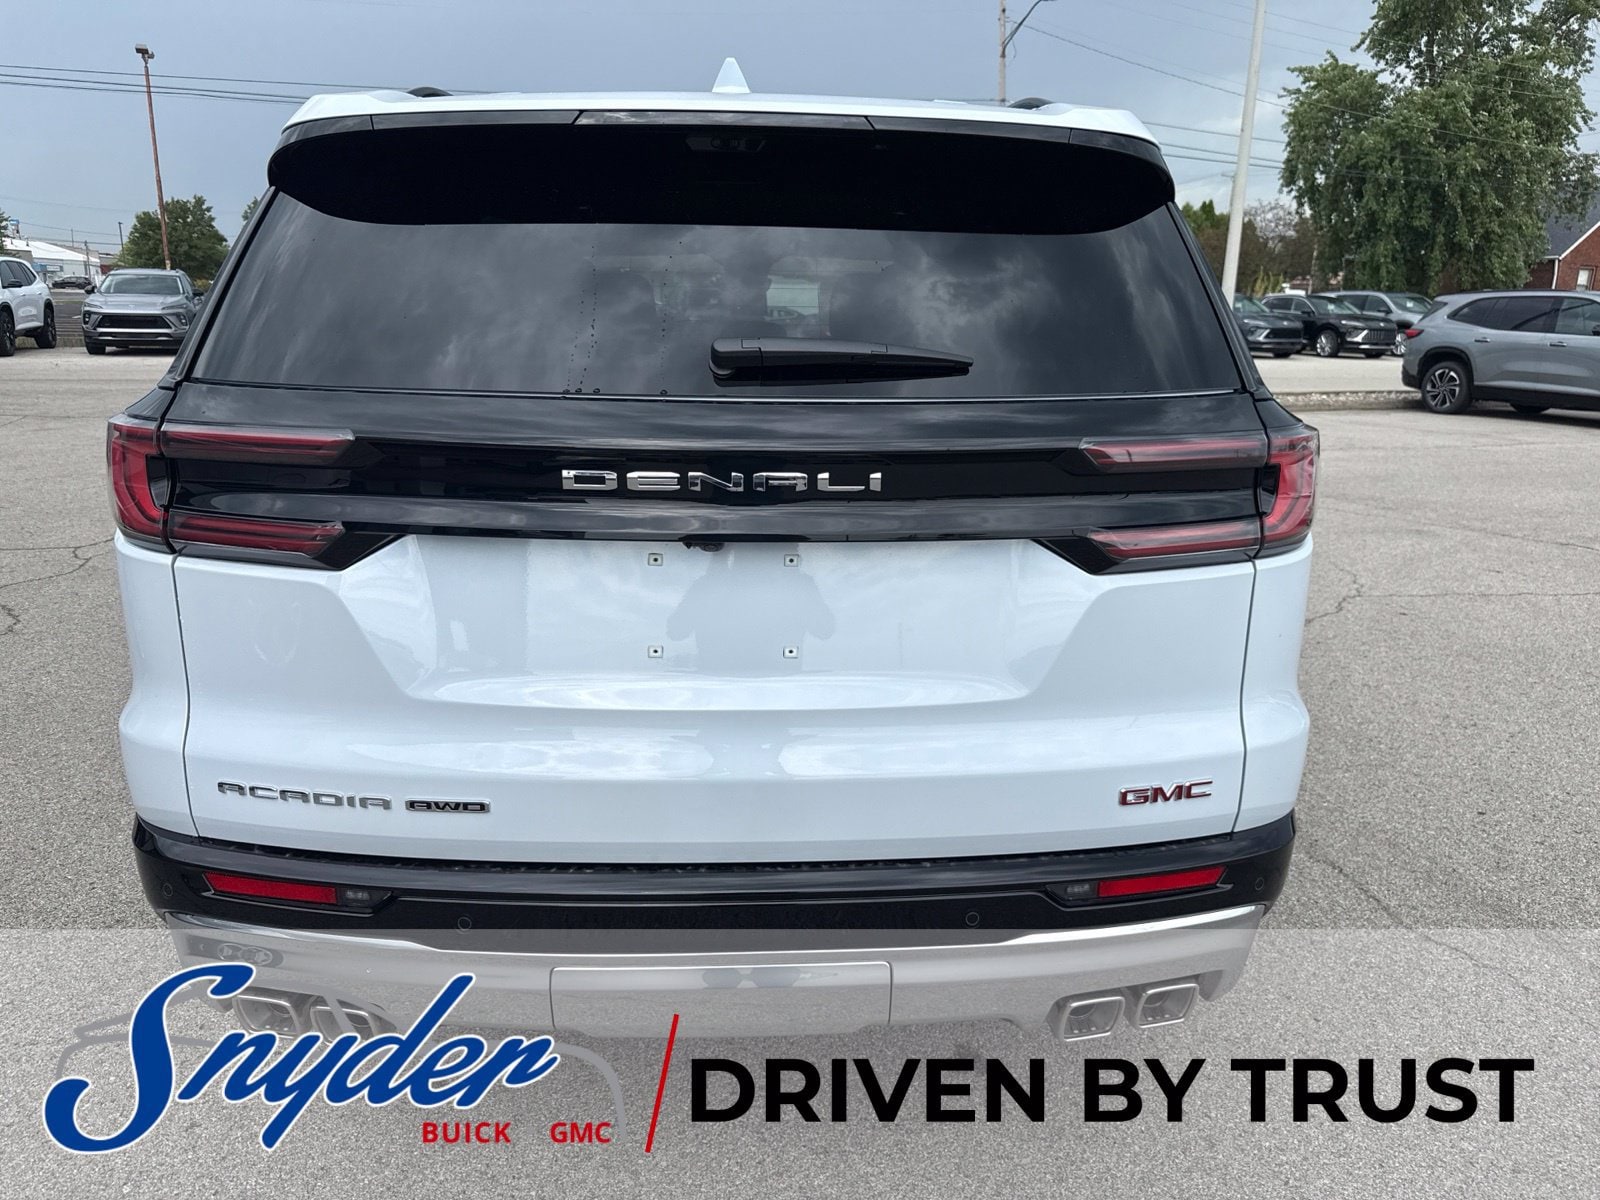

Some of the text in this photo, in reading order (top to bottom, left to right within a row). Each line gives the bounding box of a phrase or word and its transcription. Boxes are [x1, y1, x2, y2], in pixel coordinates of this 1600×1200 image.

[561, 469, 882, 492] DENALI
[217, 780, 490, 813] ACADIA AWD
[1119, 779, 1213, 805] GMC
